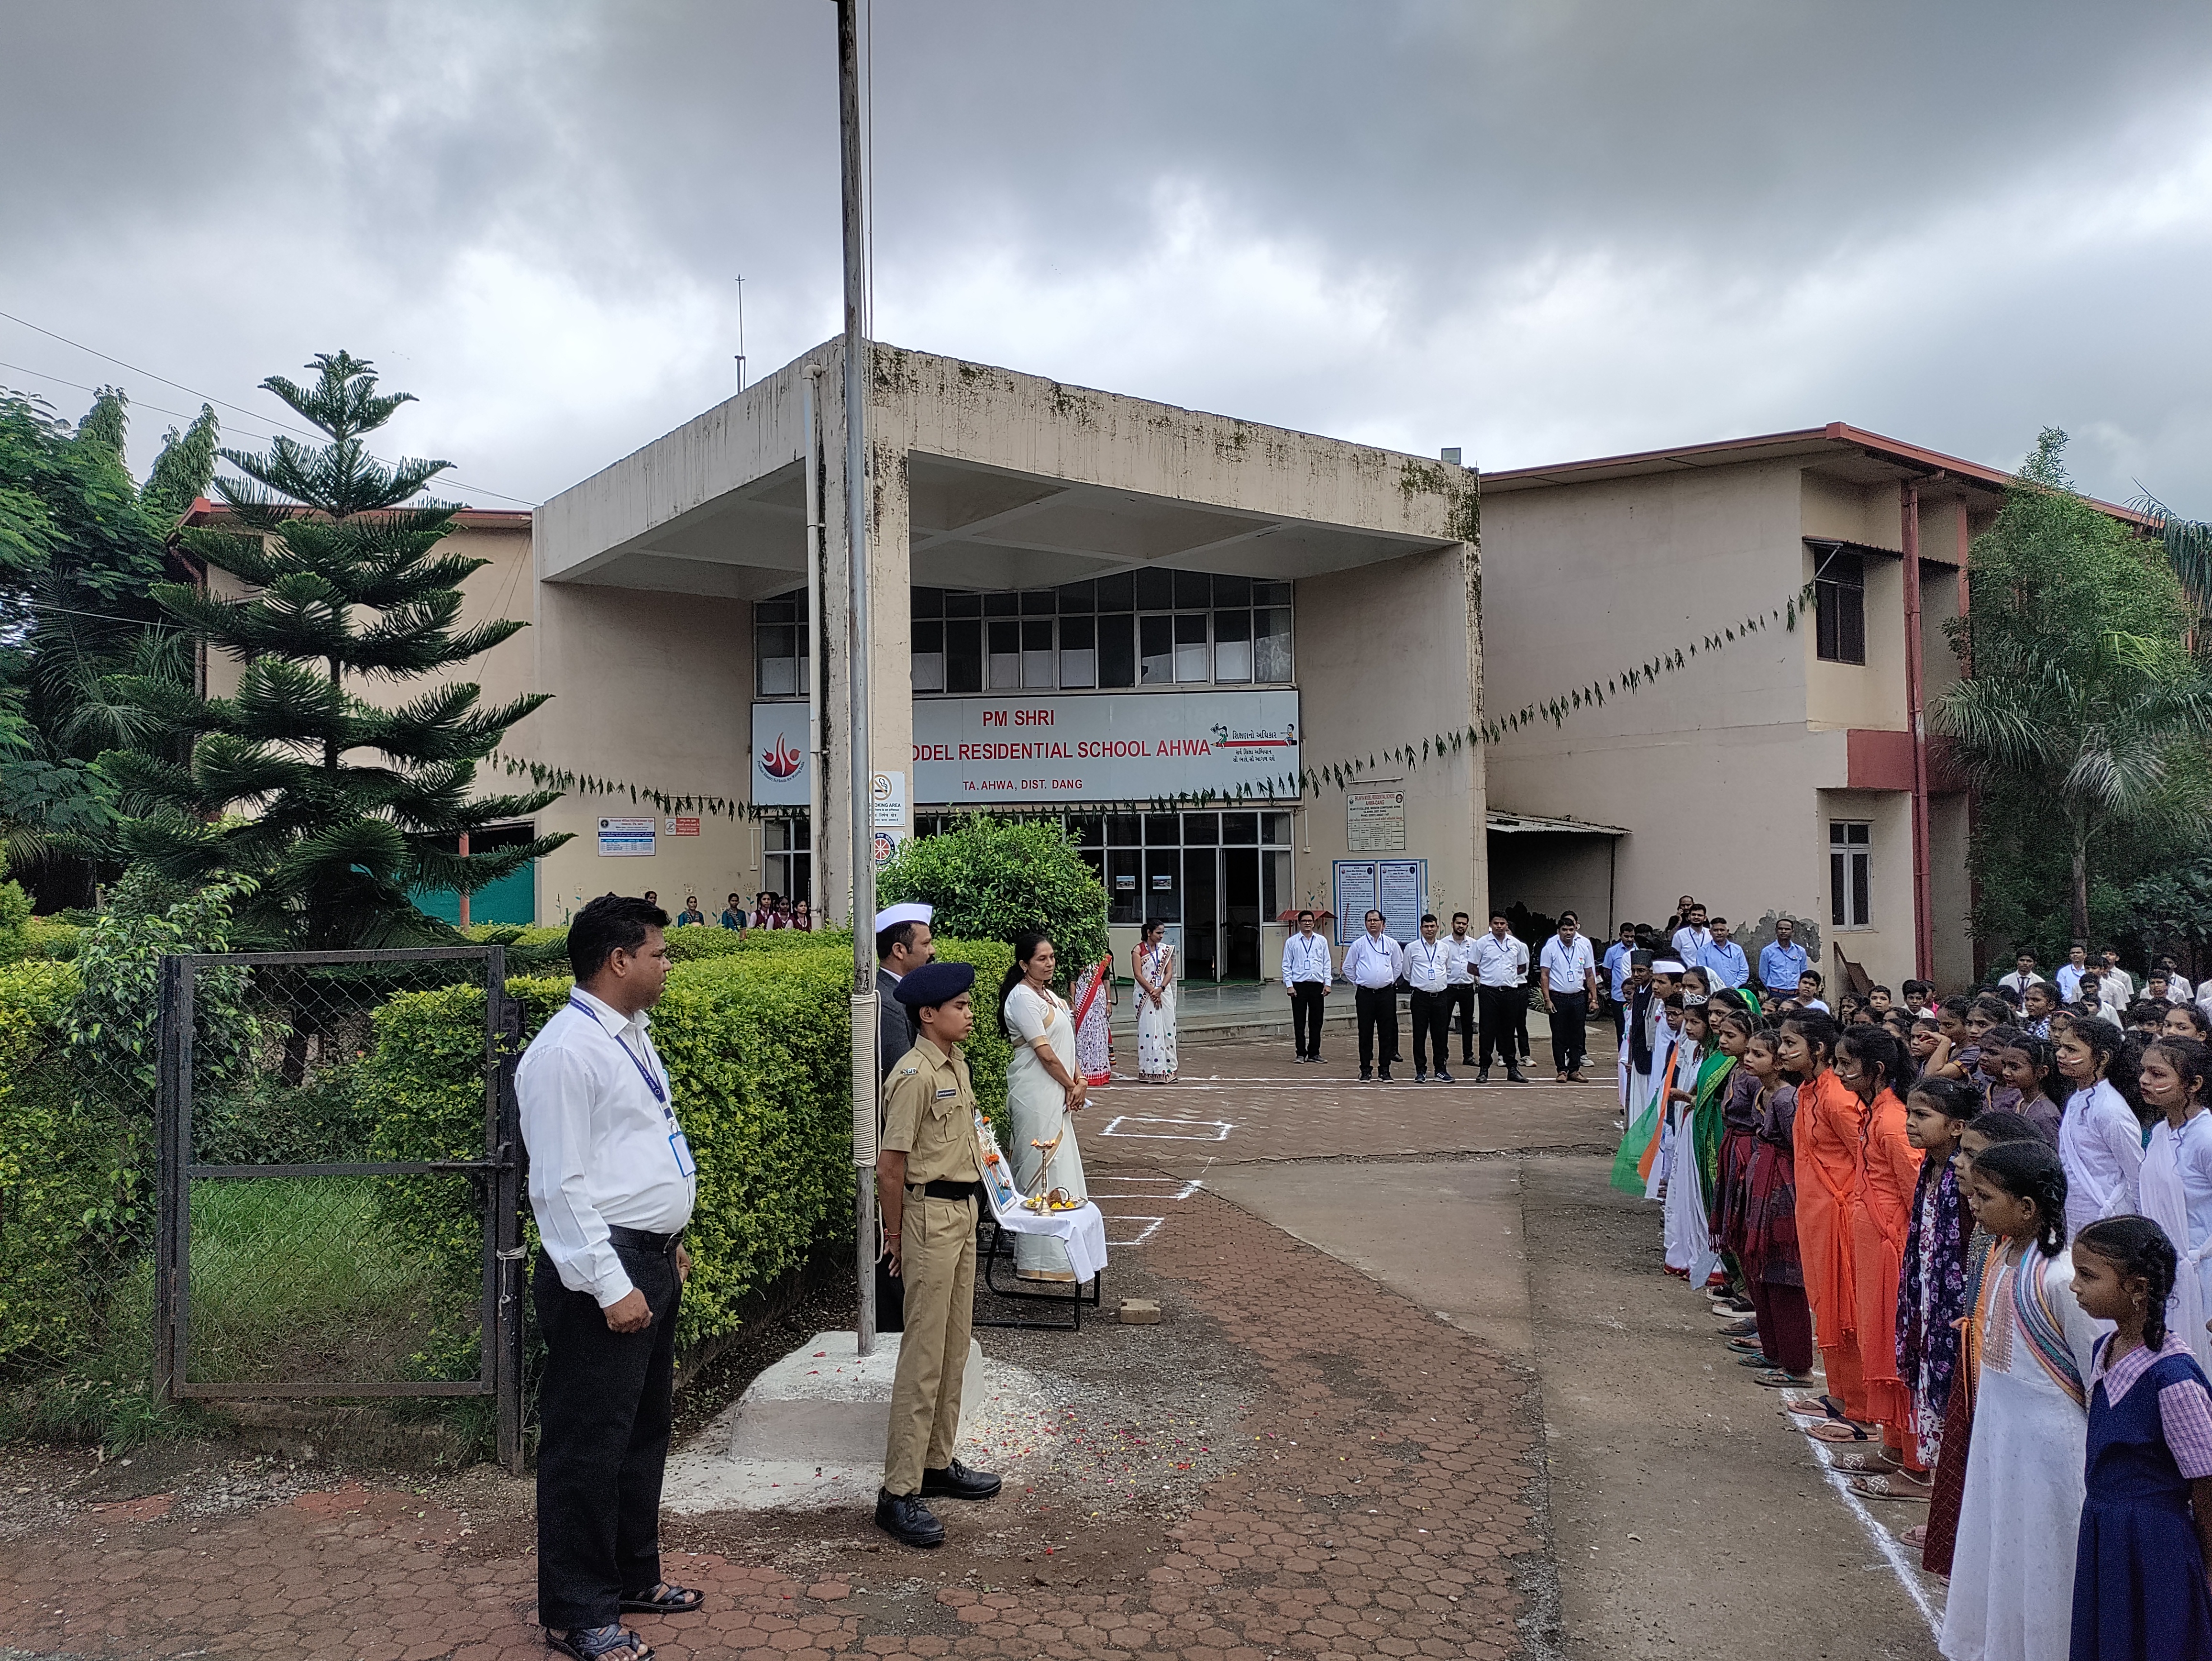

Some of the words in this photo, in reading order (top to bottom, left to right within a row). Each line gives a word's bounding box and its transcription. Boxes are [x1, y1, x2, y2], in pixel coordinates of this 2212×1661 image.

[983, 710, 1007, 727] PM
[1014, 709, 1054, 726] SHRI
[1232, 730, 1255, 740] શિક્ષણનો
[1256, 730, 1277, 739] અધિકાર
[912, 744, 954, 761] ODEL
[959, 742, 1073, 760] RESIDENTIAL
[1077, 741, 1151, 758] SCHOOL
[1156, 739, 1211, 756] AHWA
[1021, 779, 1047, 789] DIST.
[1052, 779, 1083, 789] DANG
